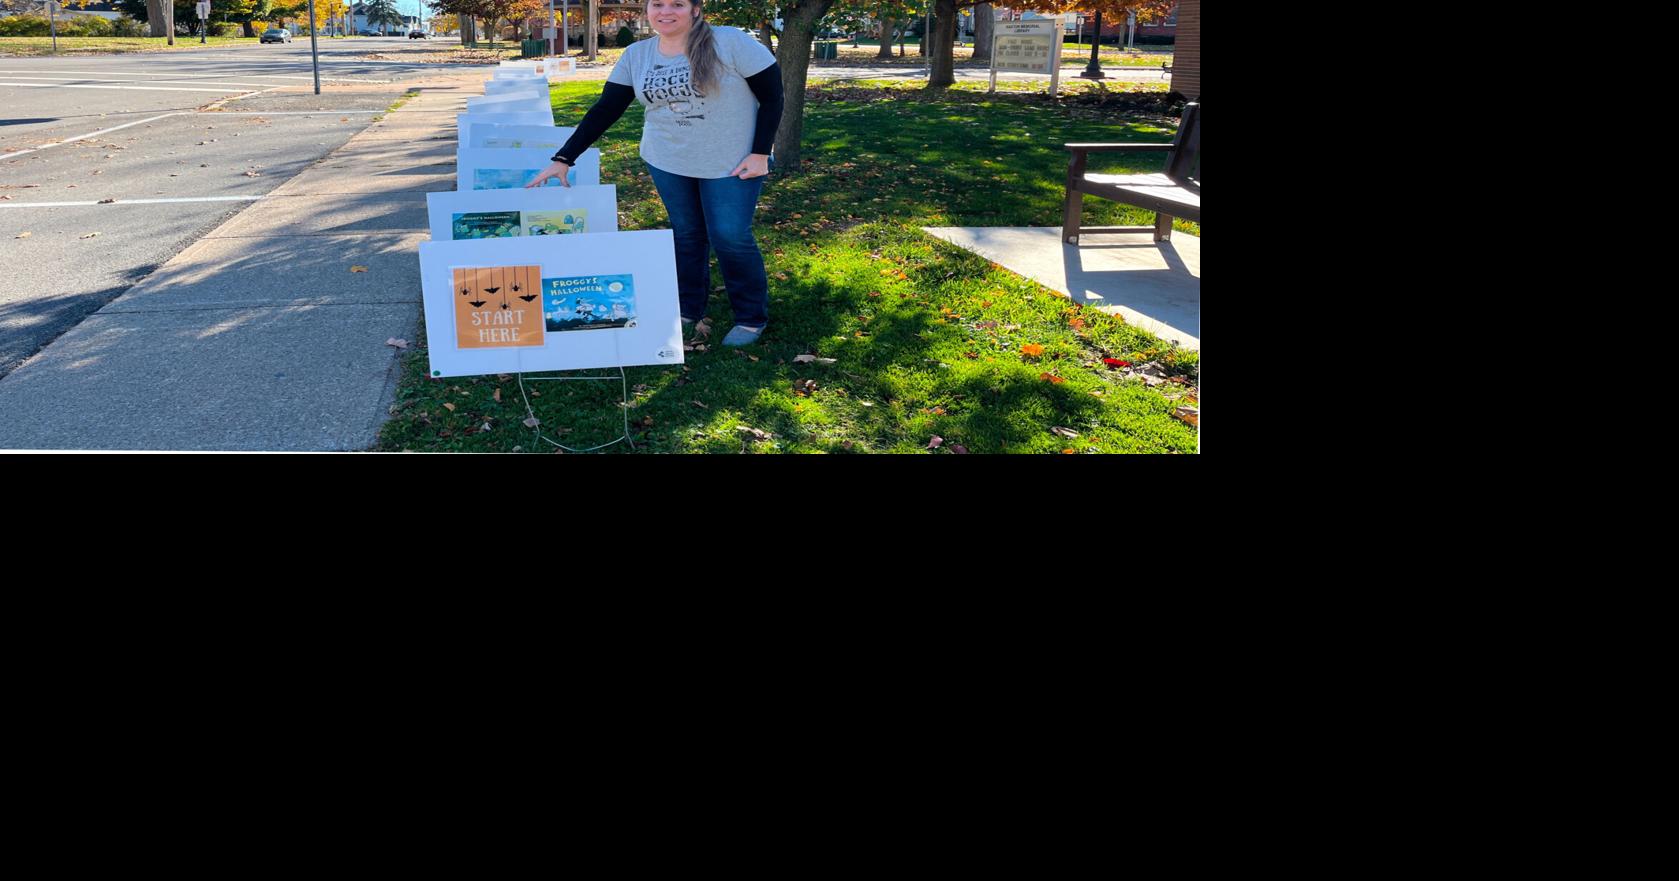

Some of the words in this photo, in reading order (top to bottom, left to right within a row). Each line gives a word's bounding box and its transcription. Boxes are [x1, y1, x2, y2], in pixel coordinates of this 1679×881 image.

[643, 72, 689, 90] HOCU
[551, 285, 603, 296] HALLOWEEN
[471, 309, 526, 326] START
[479, 327, 521, 343] HERE
